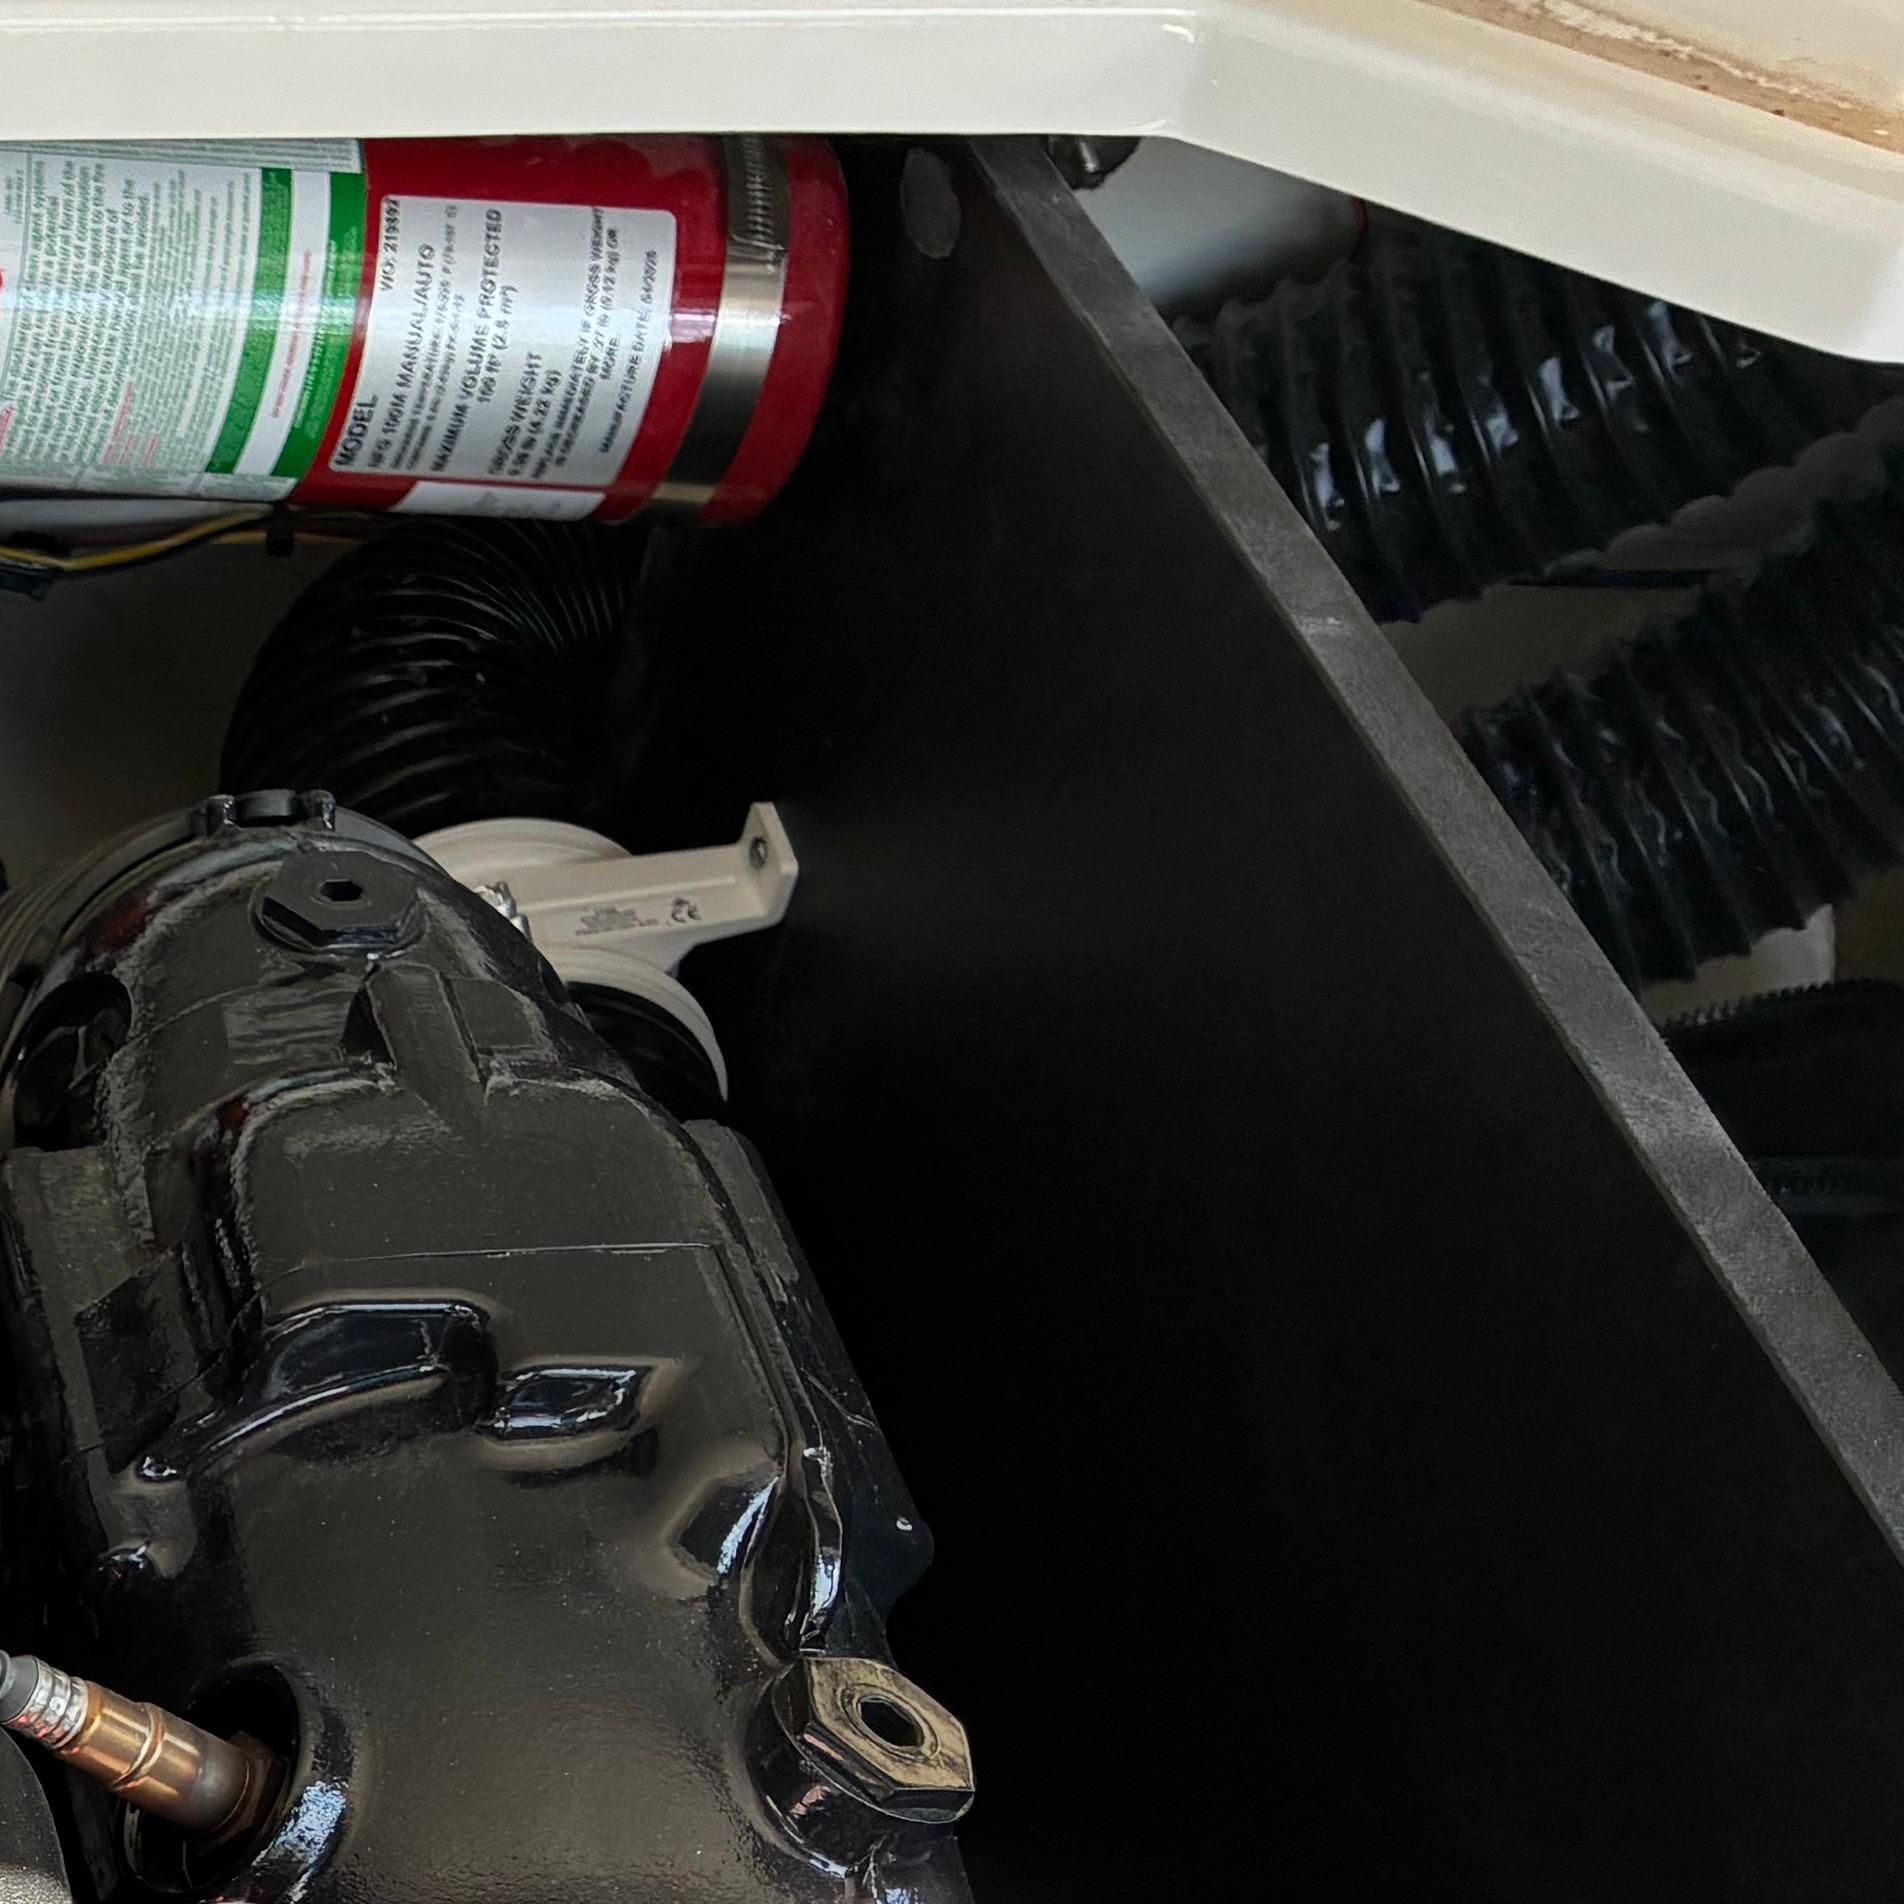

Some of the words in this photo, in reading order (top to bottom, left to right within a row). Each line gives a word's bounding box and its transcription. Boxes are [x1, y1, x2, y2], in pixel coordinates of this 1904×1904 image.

[396, 242, 435, 387] MANUAL/AUTO
[458, 324, 490, 399] VOLUME
[474, 208, 502, 318] PROTECTED
[334, 394, 379, 465] MODEL
[508, 351, 543, 421] WEIGHT
